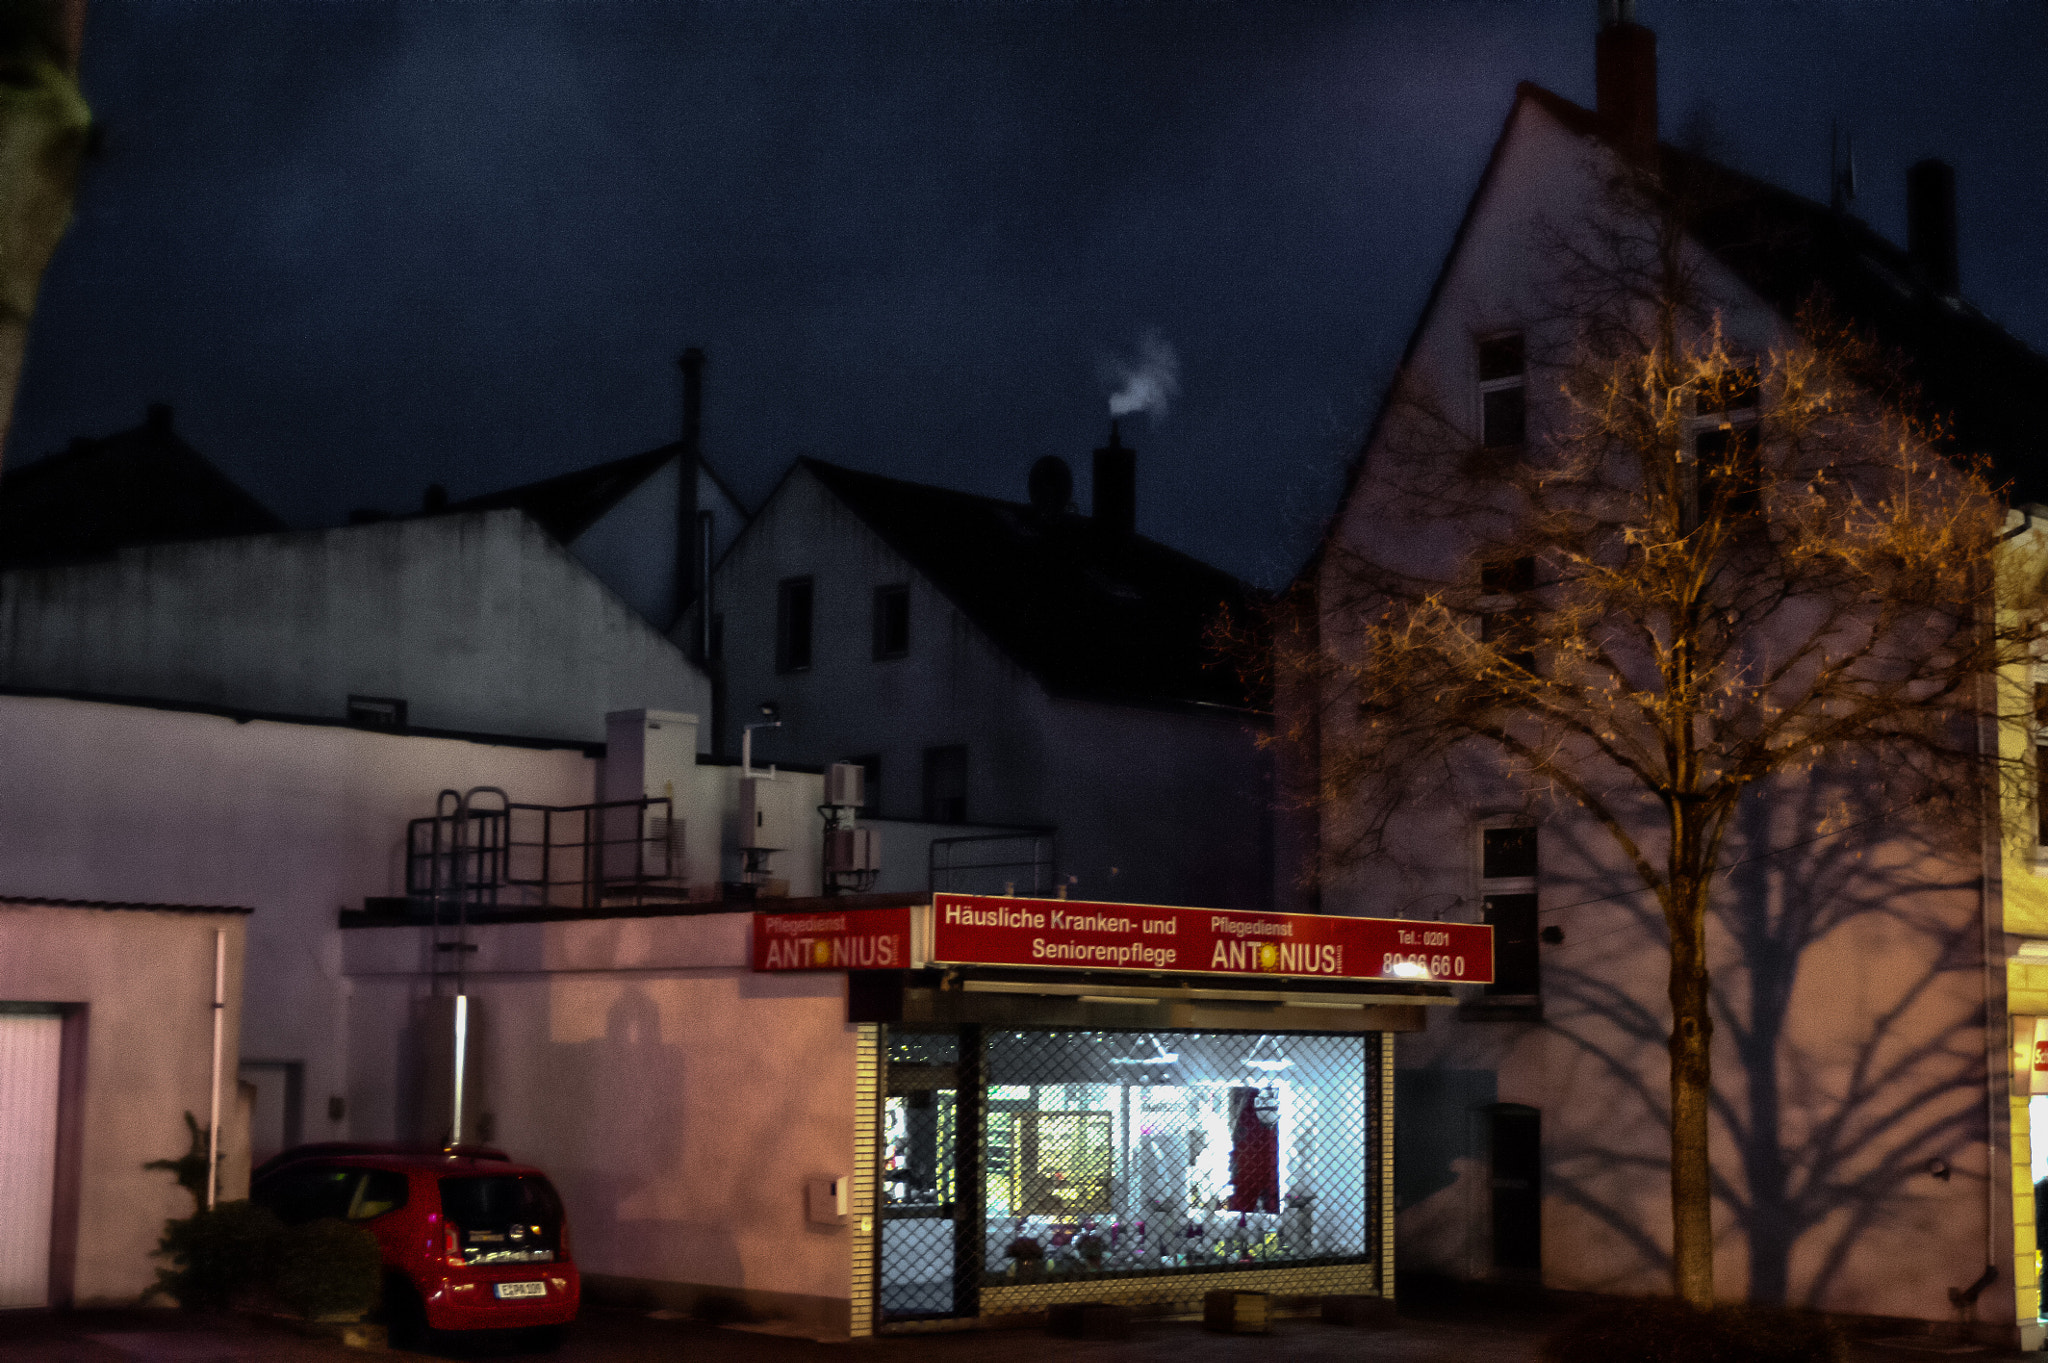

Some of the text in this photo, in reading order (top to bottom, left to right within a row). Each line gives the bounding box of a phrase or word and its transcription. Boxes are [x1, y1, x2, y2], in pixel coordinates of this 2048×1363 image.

[765, 915, 847, 936] Pflegedienst
[945, 904, 1177, 935] Häusliche Kranken- und
[1211, 916, 1293, 938] Pflegedienst
[1423, 931, 1450, 946] 0201
[1032, 938, 1177, 967] Seniorenpflege
[1430, 954, 1451, 976] 66
[1454, 956, 1465, 977] 0
